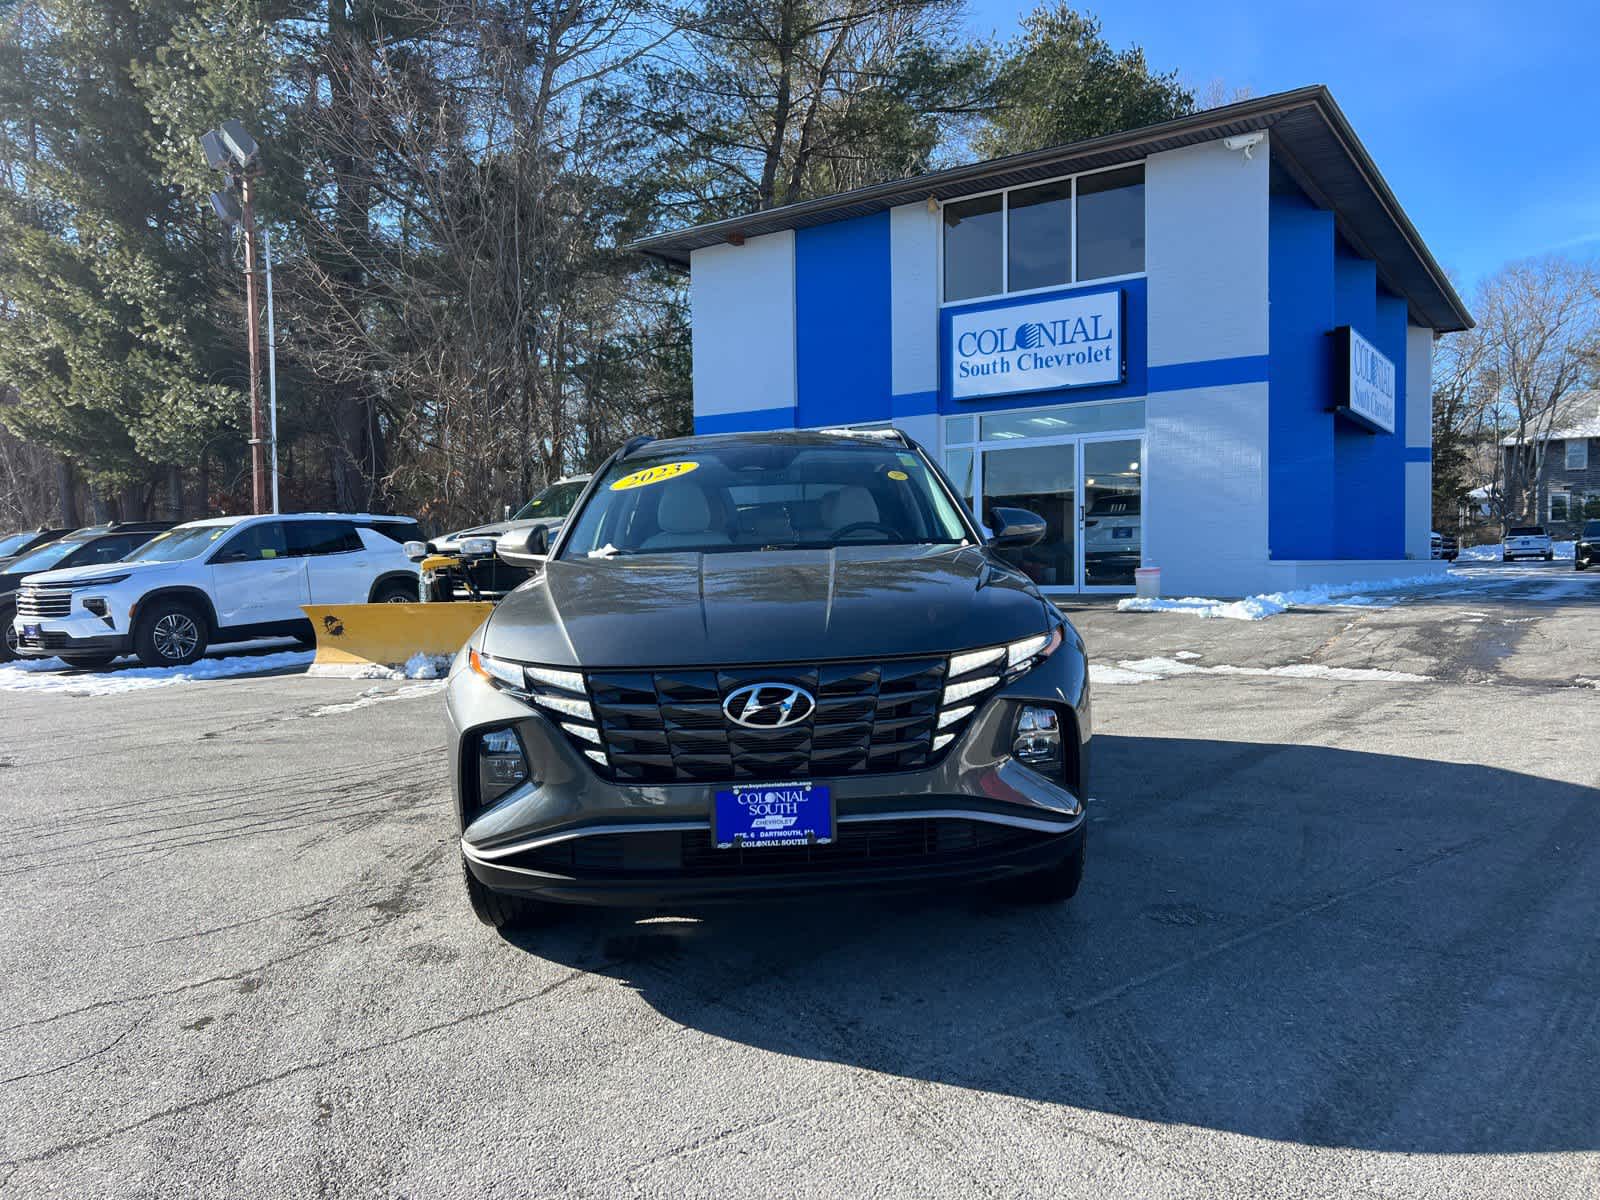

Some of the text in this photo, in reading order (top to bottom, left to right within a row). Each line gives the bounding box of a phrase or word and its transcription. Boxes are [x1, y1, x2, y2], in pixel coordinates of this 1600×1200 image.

[958, 315, 1112, 357] COLONIAL
[959, 345, 1112, 378] South Chevrolet
[629, 464, 682, 486] 2023
[737, 791, 808, 804] COLONIAL
[749, 803, 797, 816] SOUTH
[760, 830, 803, 838] DARTMOUTH,
[741, 838, 808, 848] COLONIAL SOUTH
